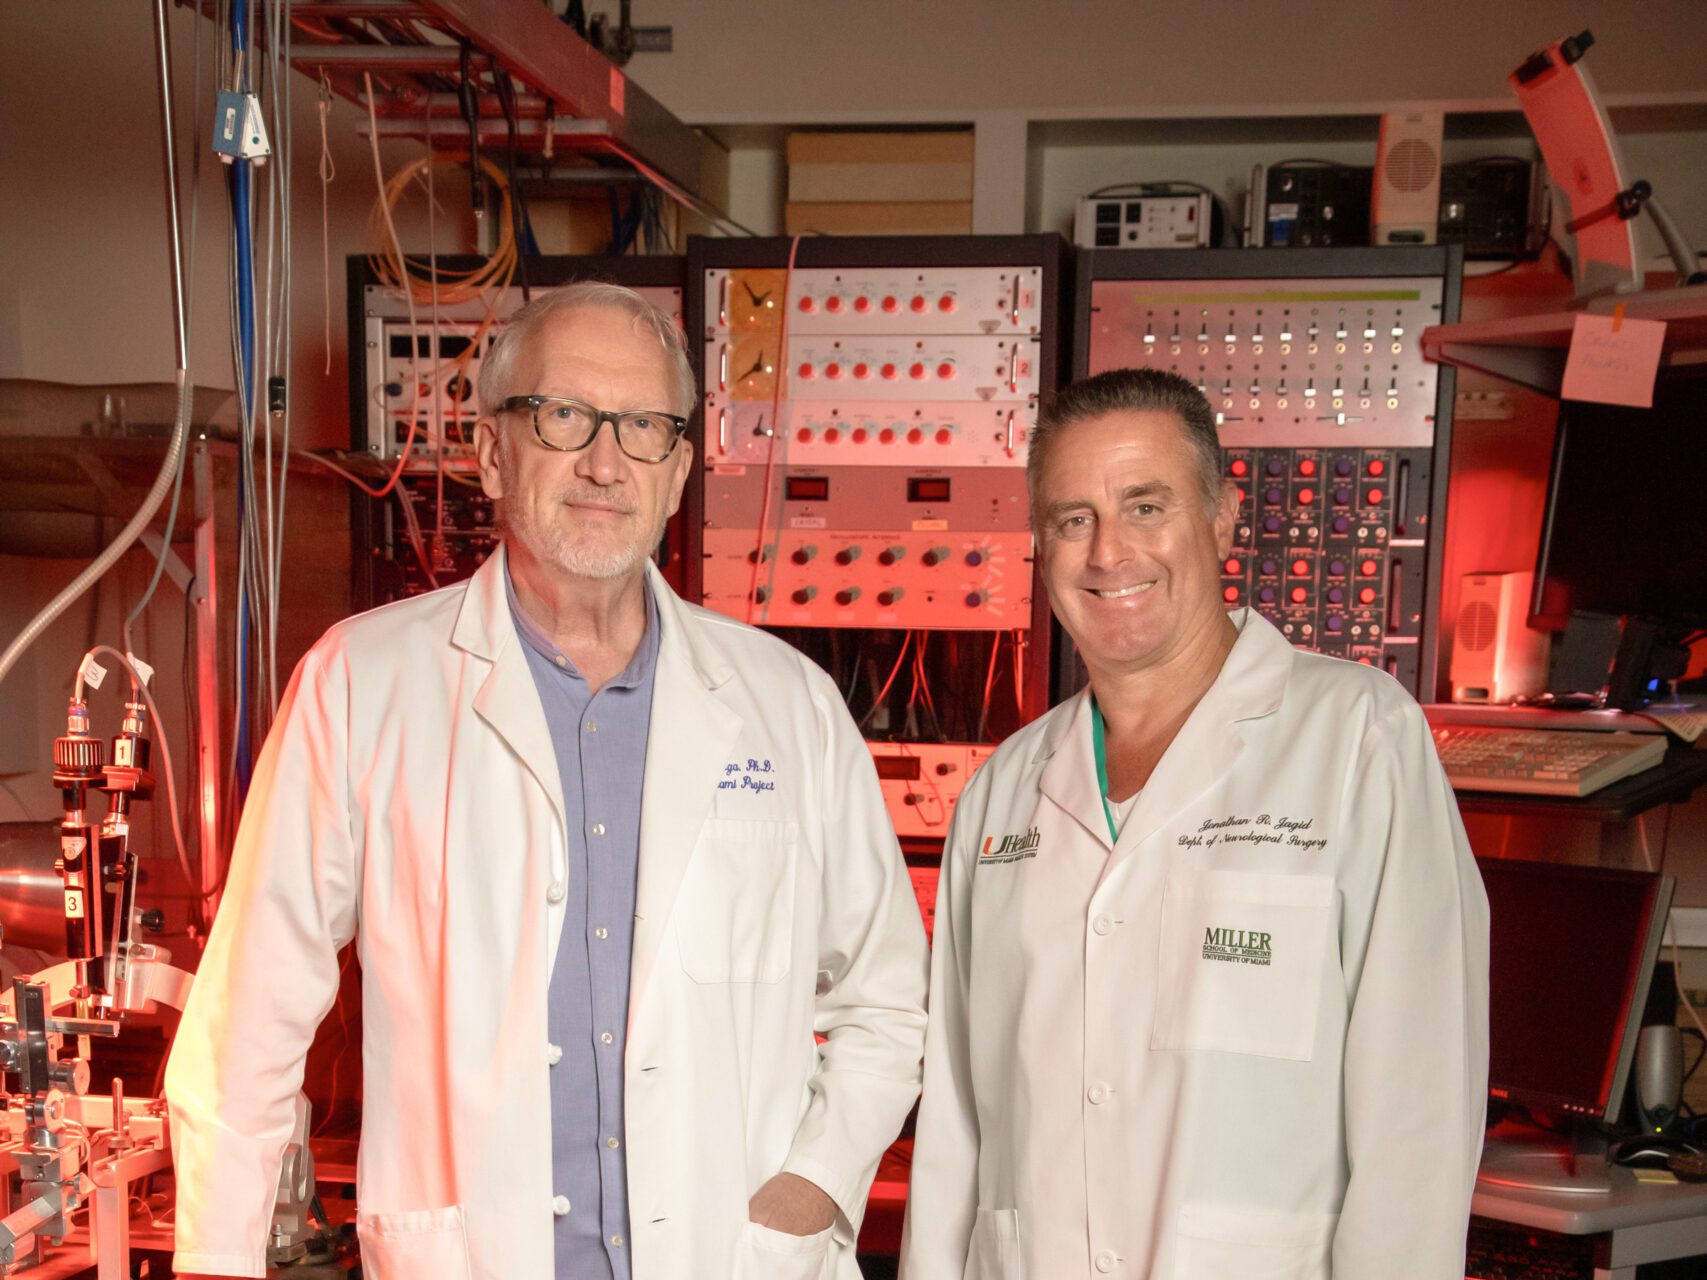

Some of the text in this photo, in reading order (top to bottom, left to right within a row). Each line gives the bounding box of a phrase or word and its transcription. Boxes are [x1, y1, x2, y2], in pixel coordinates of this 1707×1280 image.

[119, 745, 126, 760] 1
[740, 775, 775, 794] Project
[1198, 814, 1314, 833] Jonathan R. Jagid
[1206, 834, 1219, 849] of
[1219, 830, 1284, 846] Neurological
[1286, 834, 1328, 851] Surgery
[68, 896, 77, 912] 3
[1203, 927, 1273, 951] MILLER
[1202, 945, 1228, 953] SCHOOL
[1202, 953, 1240, 963] UNIVERSITY
[1250, 958, 1271, 966] MIAMI
